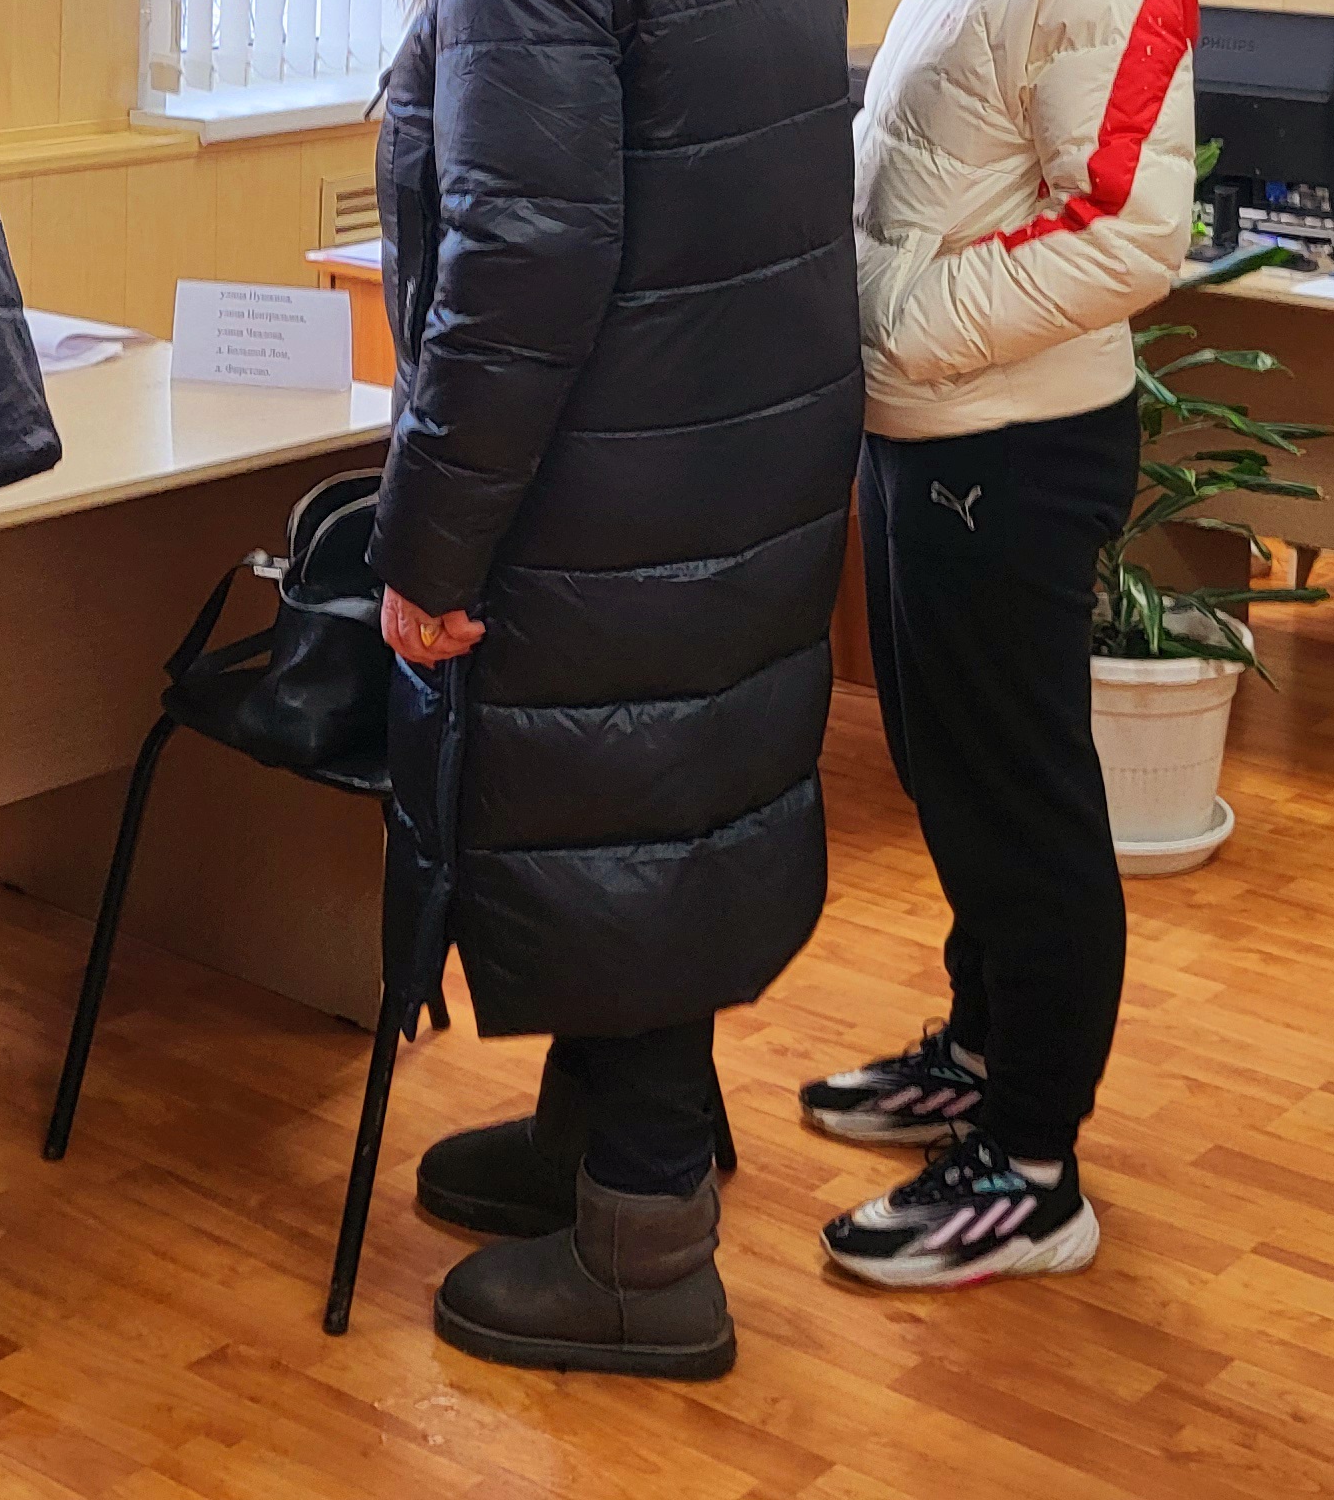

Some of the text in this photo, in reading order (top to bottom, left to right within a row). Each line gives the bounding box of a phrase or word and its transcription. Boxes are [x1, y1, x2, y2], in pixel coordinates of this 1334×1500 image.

[1202, 37, 1255, 52] PHILIPS
[220, 291, 246, 301] улица
[218, 308, 307, 323] улица Центральная,
[217, 328, 243, 337] улица
[227, 346, 266, 357] Большой
[268, 348, 290, 360] Лом,
